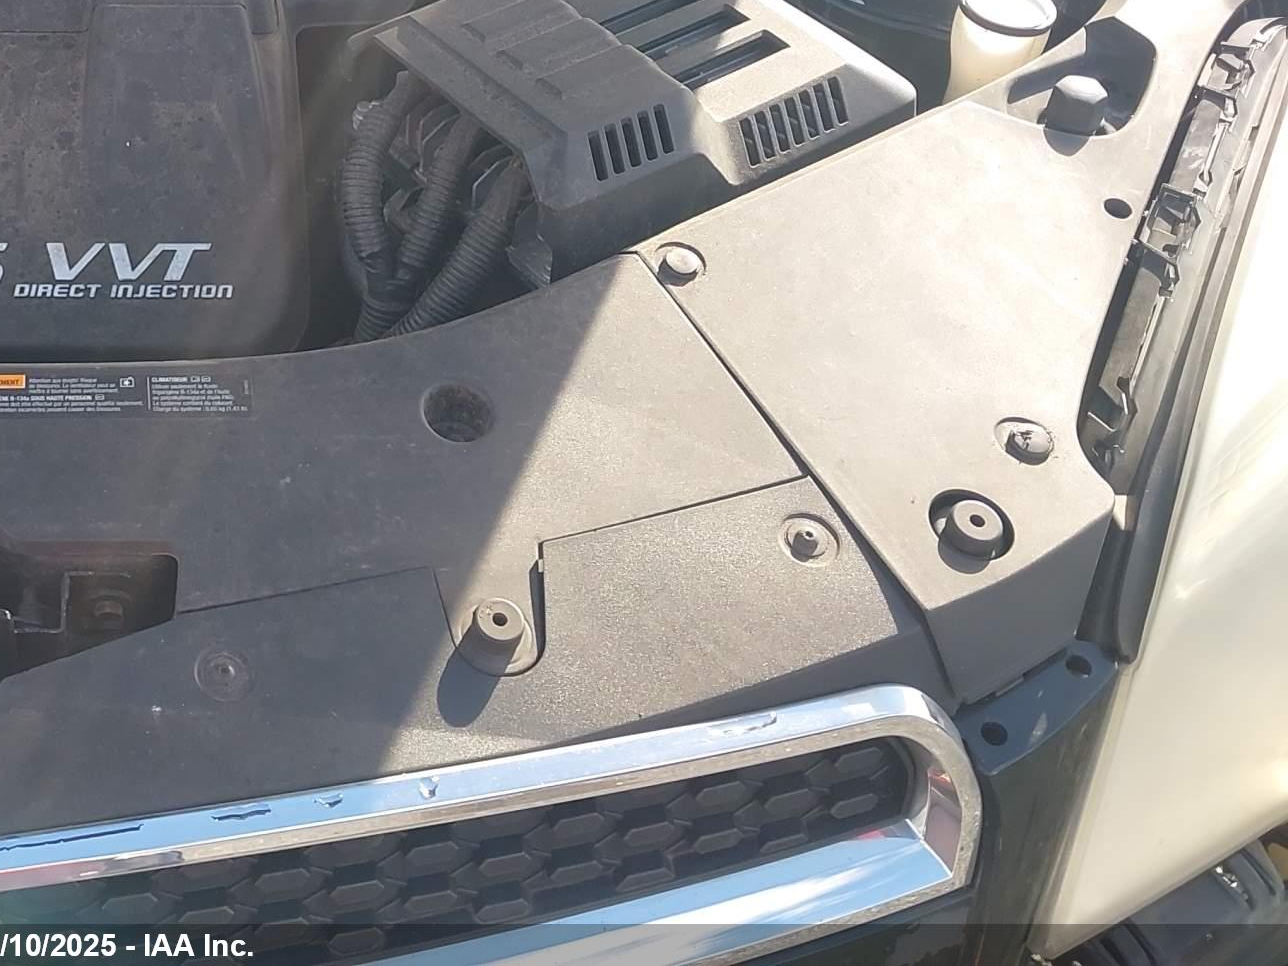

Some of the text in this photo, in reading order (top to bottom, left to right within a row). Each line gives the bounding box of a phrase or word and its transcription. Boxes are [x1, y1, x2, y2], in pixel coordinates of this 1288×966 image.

[45, 242, 212, 281] VVT
[14, 283, 233, 299] DIRECT INJECTION
